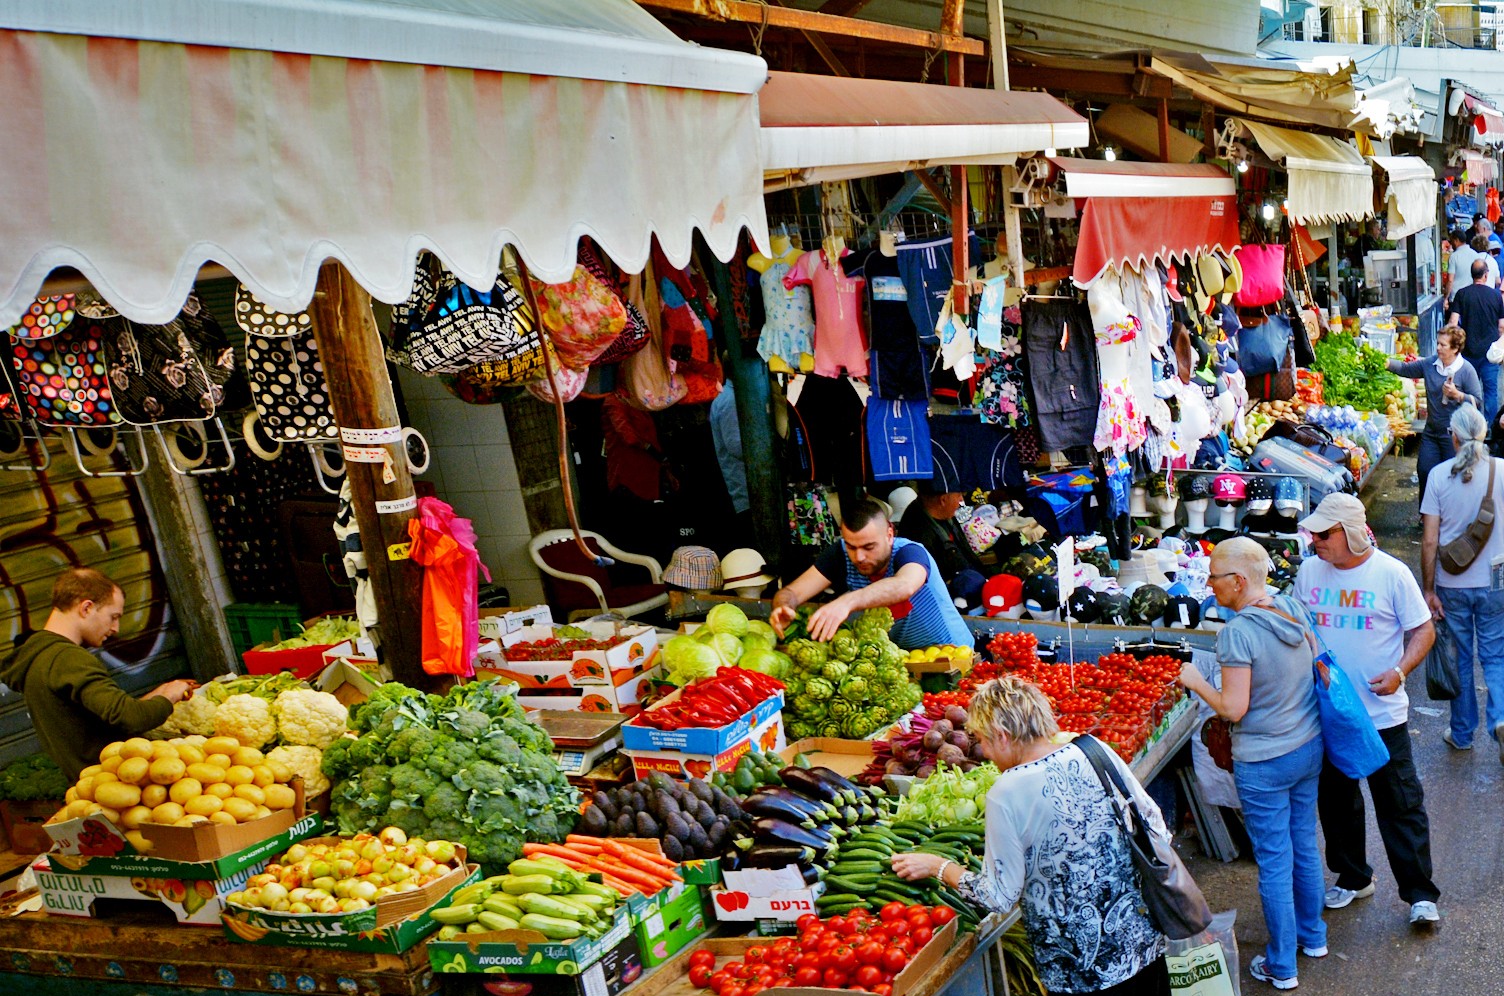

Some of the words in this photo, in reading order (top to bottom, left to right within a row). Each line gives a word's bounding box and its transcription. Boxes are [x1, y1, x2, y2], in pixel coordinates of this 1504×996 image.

[467, 305, 484, 313] AVIV
[289, 817, 317, 840] בננות
[39, 874, 107, 895] מובחרים
[45, 894, 86, 911] פירות
[770, 900, 811, 911] ברעם
[479, 956, 523, 966] AVOCADOS
